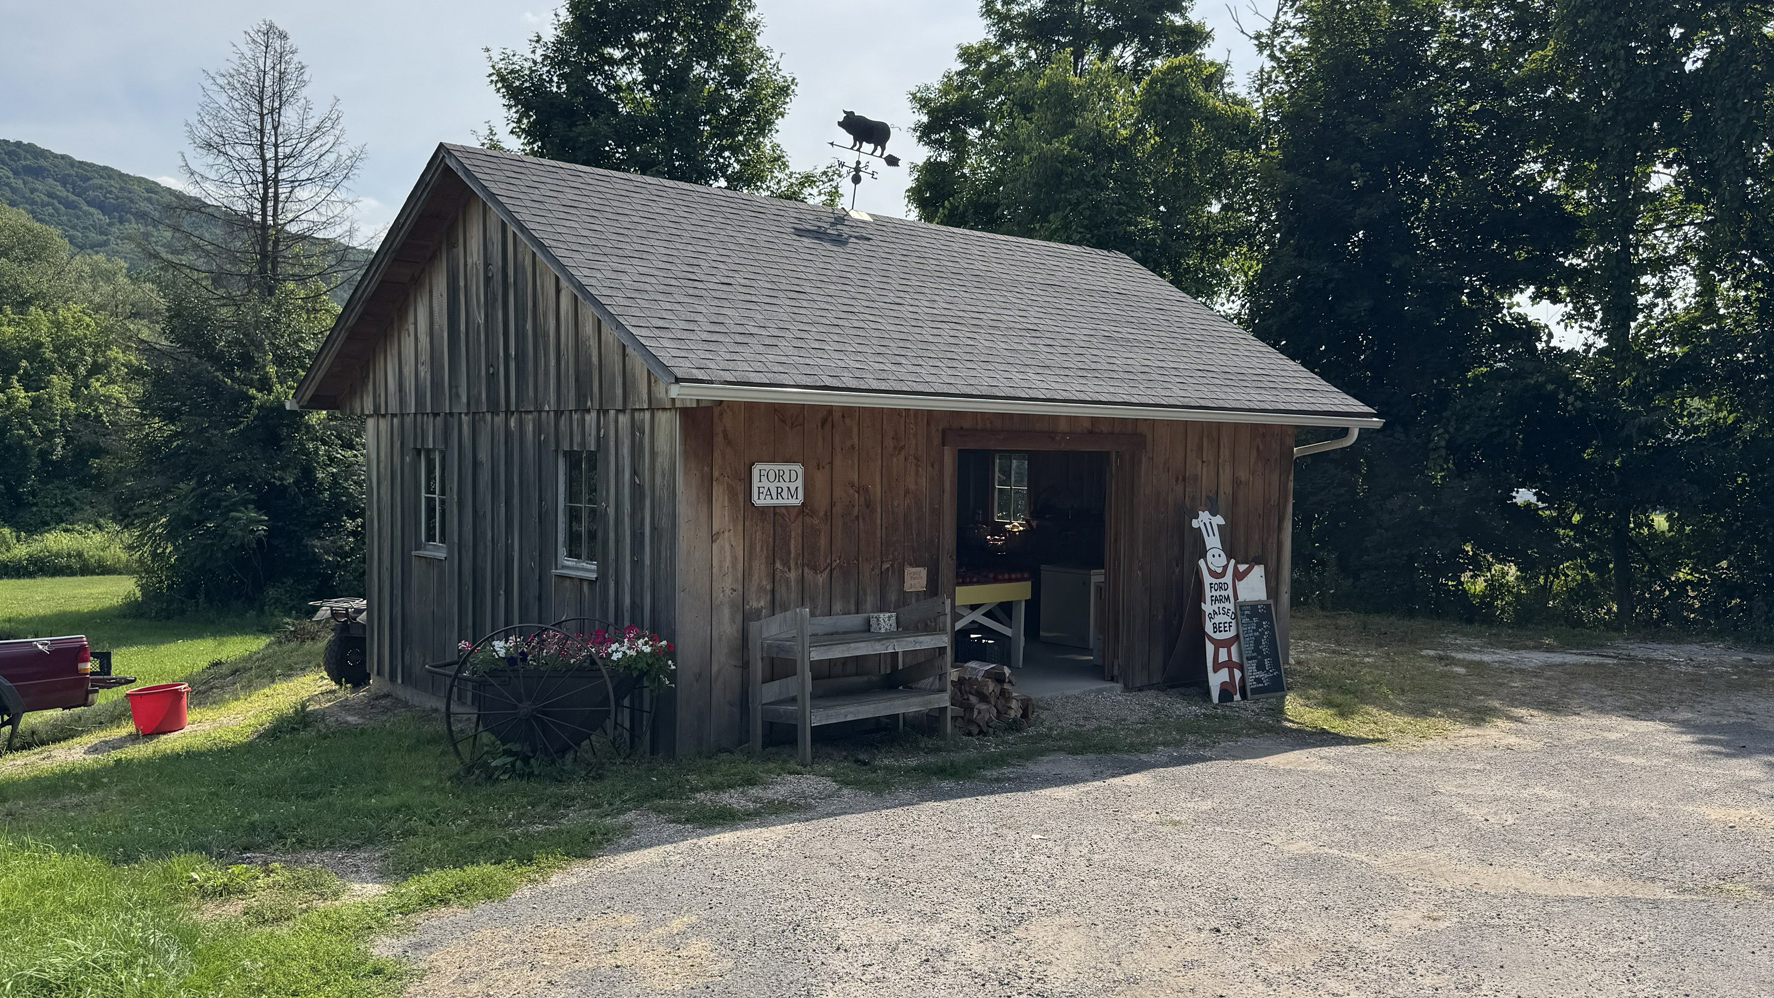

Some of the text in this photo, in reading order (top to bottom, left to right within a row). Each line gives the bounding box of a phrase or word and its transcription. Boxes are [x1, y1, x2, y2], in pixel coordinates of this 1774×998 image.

[758, 468, 799, 483] FORD
[757, 486, 800, 500] FARM
[1209, 582, 1229, 593] FORD
[1210, 594, 1231, 606] FARM
[1207, 606, 1236, 623] RAISED
[1212, 621, 1233, 634] BEEF
